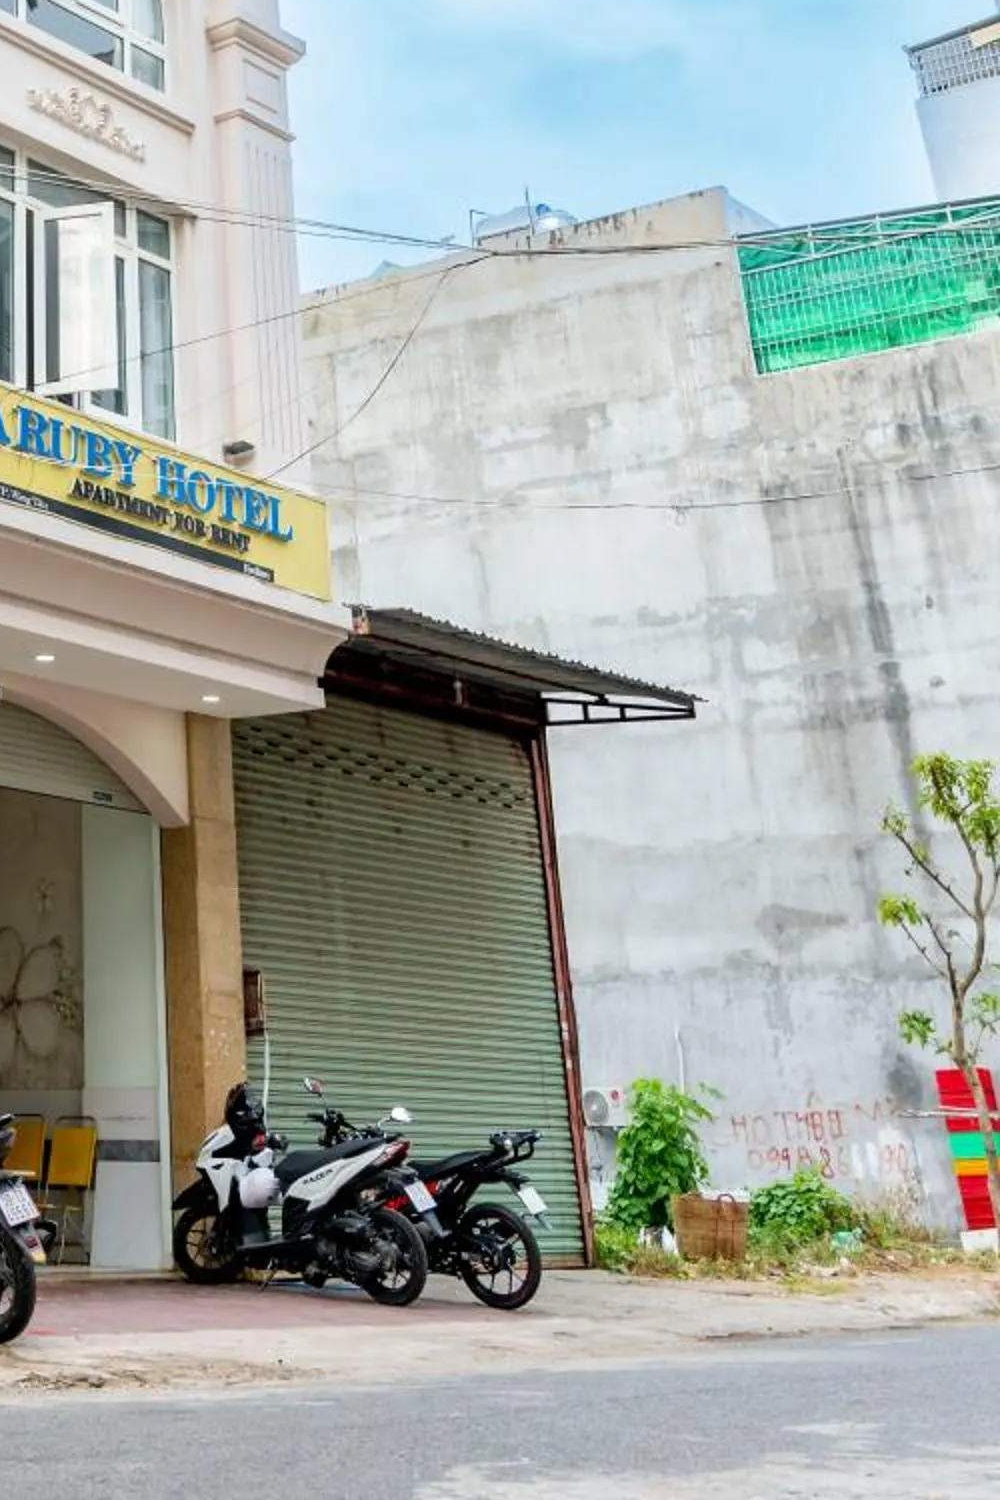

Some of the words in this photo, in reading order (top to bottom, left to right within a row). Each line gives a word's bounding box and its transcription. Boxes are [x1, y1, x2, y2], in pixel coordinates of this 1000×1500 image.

[14, 403, 143, 488] RUBY
[153, 454, 294, 543] HOTEL
[69, 477, 170, 526] APARTMENT
[172, 510, 207, 538] FOR
[209, 522, 250, 553] RENT
